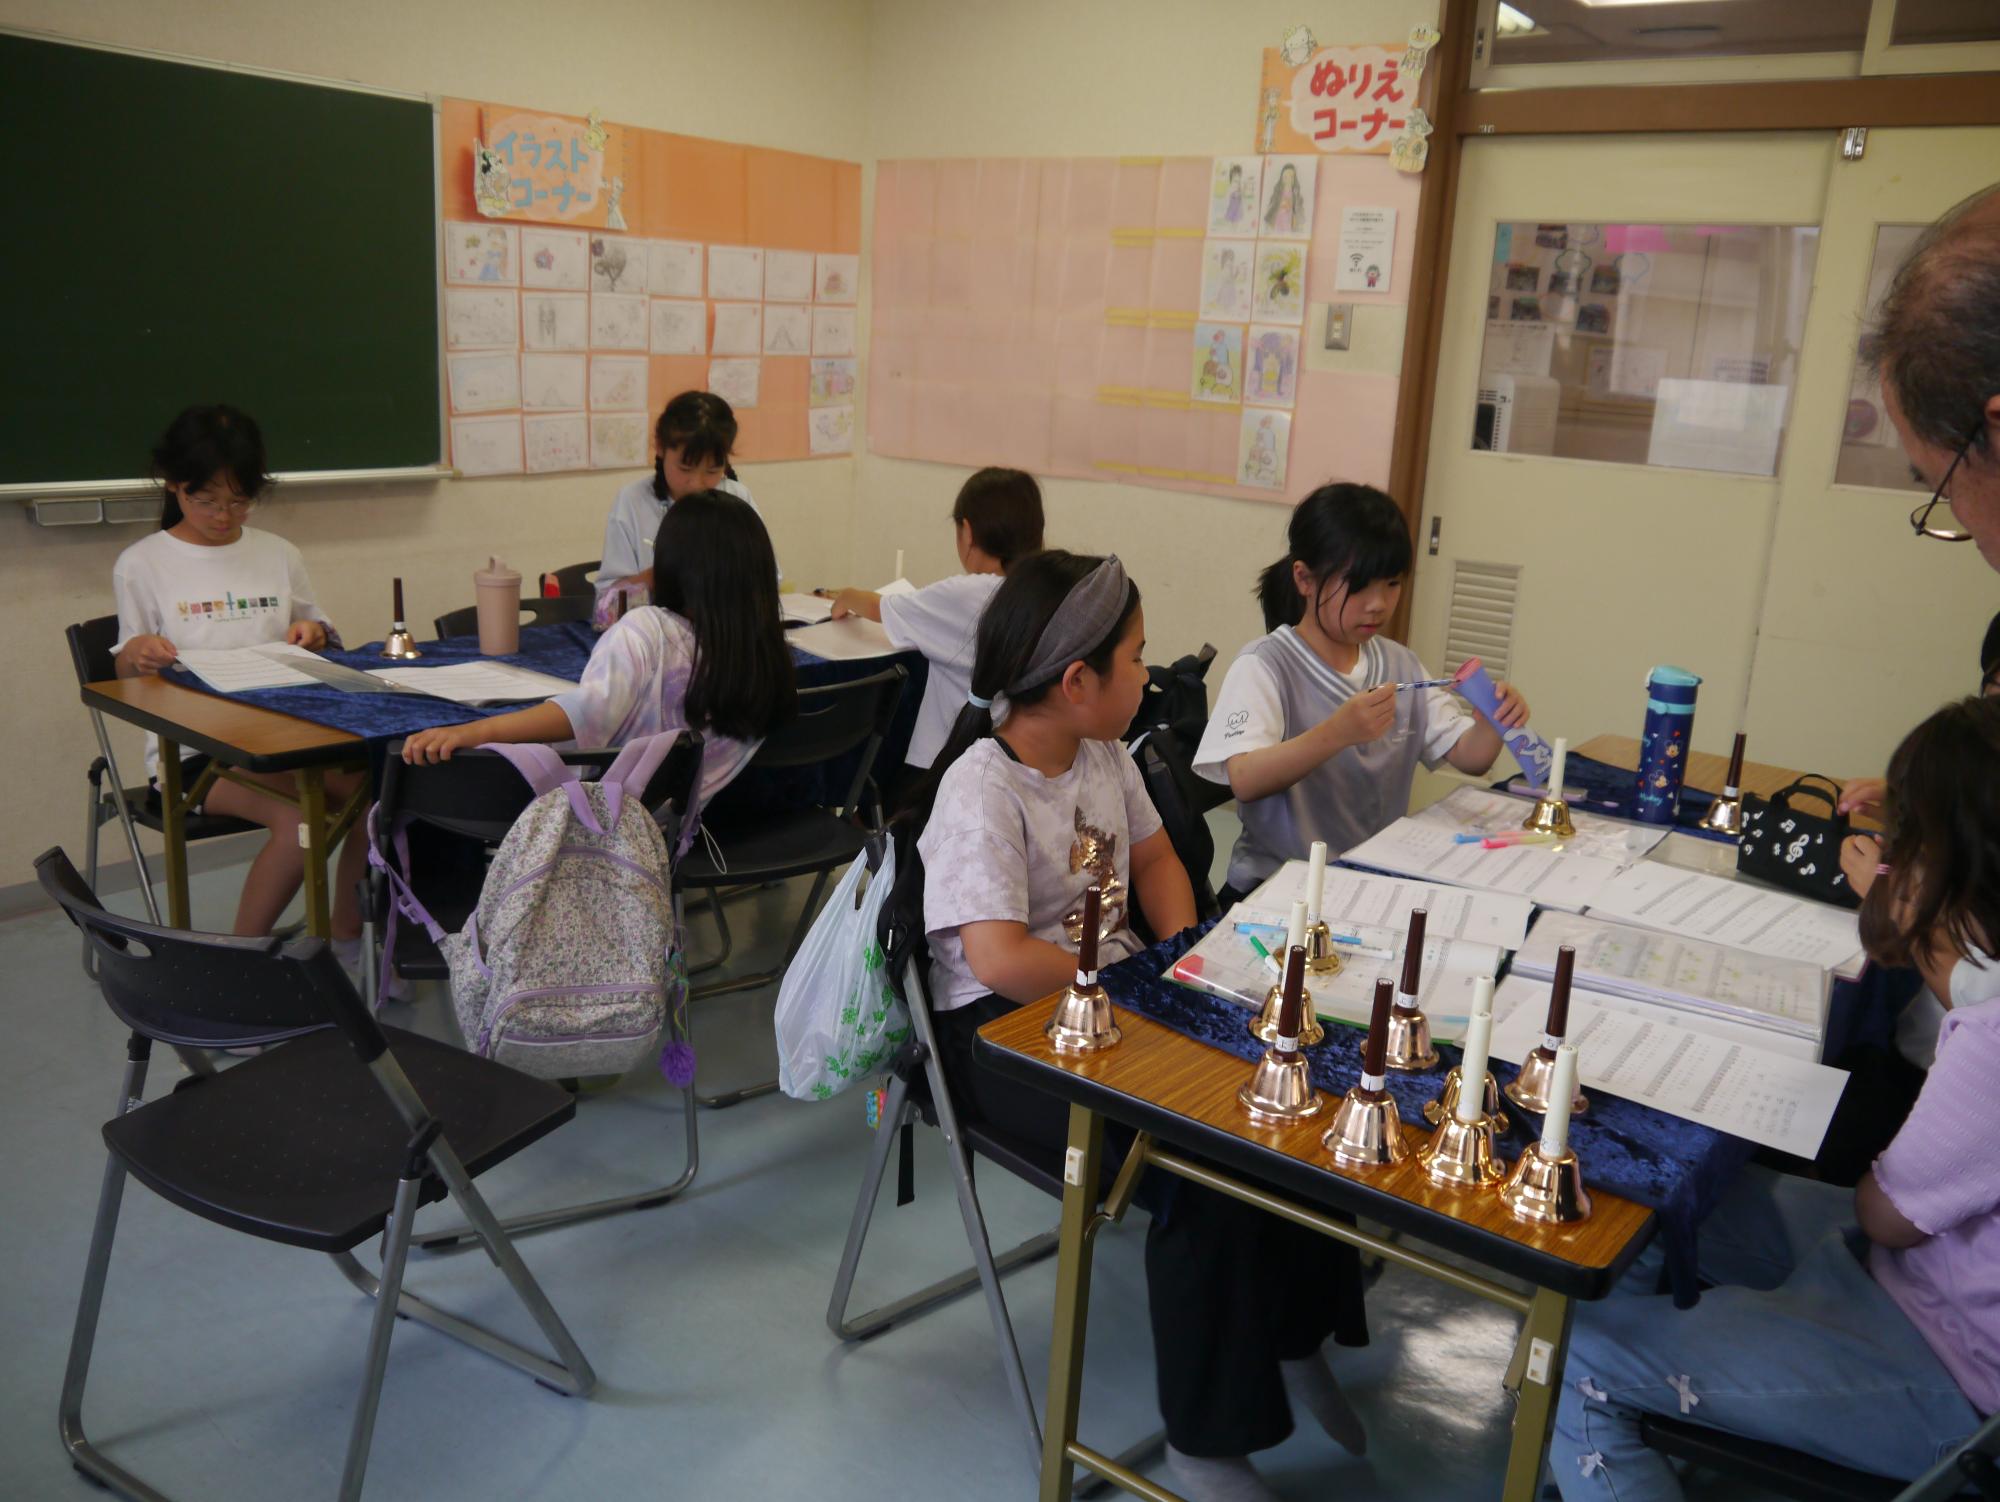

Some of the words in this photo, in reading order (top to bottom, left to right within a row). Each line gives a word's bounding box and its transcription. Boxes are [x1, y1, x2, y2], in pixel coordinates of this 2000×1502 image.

[1311, 60, 1404, 102] ぬりえ
[1314, 108, 1406, 141] コーナー
[495, 131, 589, 173] イラスト
[512, 179, 592, 212] コーナー
